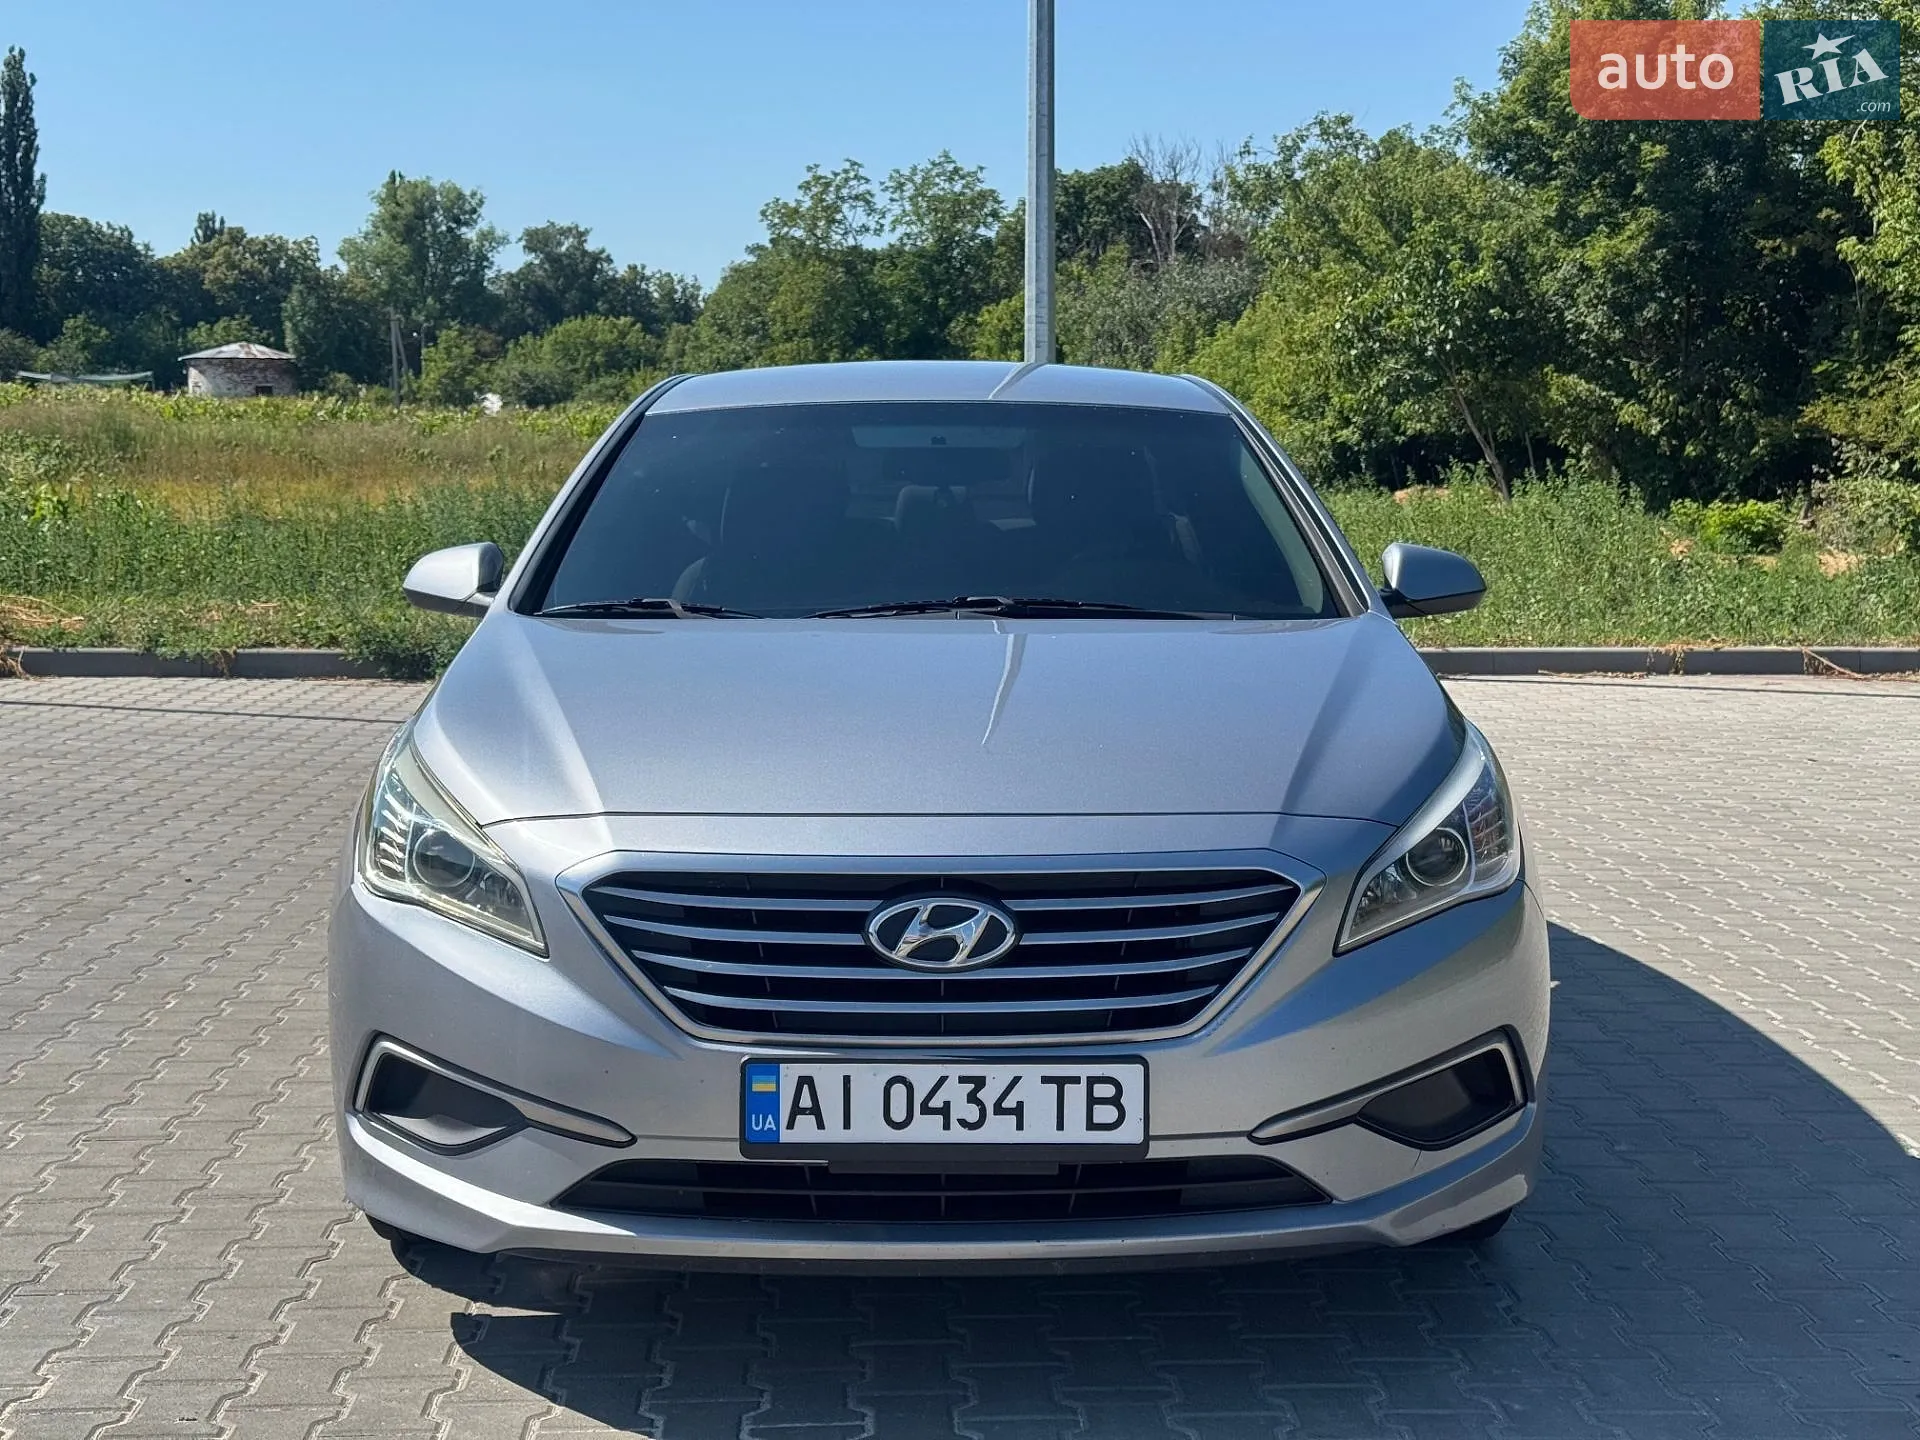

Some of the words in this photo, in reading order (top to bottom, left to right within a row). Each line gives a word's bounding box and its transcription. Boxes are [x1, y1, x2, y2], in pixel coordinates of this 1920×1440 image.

[786, 1074, 852, 1131] AI
[882, 1075, 1025, 1132] 0434
[1040, 1075, 1127, 1132] TB
[751, 1113, 777, 1132] UA
